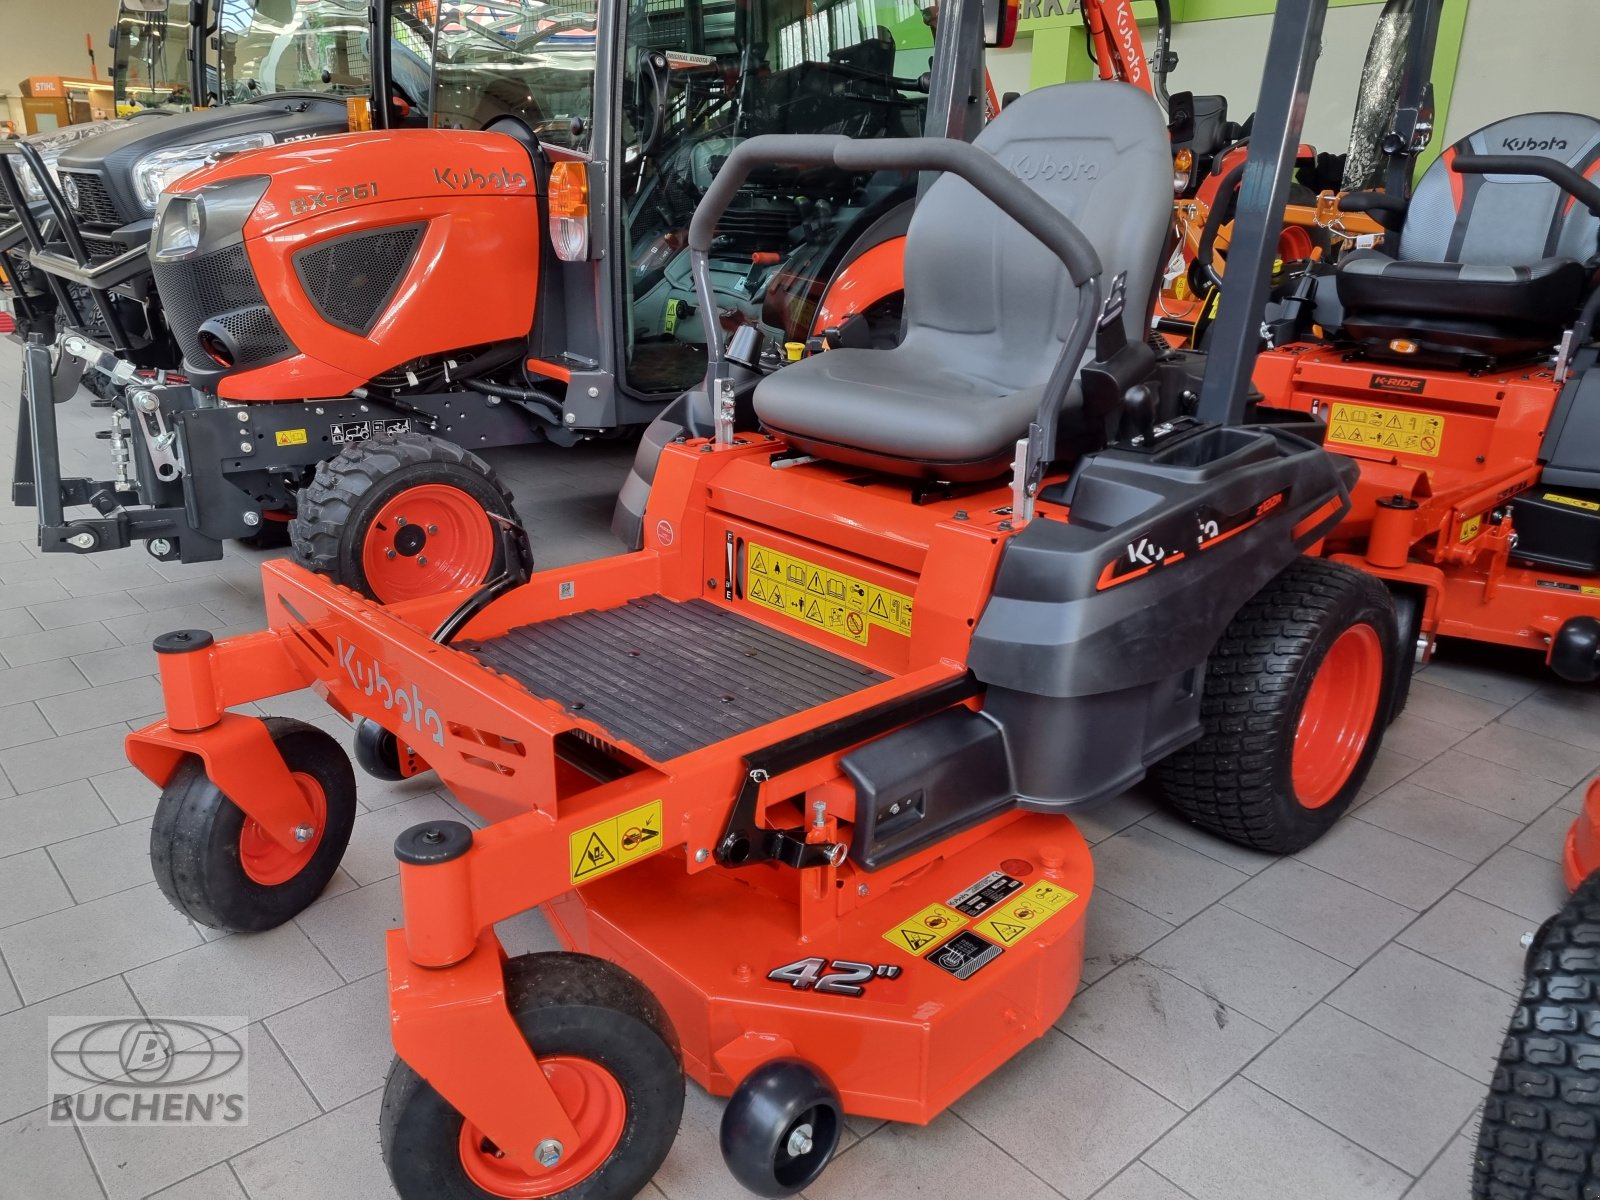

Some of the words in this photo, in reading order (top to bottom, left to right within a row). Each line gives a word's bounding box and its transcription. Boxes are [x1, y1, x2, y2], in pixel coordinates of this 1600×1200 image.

[1116, 1, 1141, 83] Kubota
[35, 82, 56, 91] STIHL
[1502, 136, 1567, 151] Kubota
[433, 166, 527, 190] Kubota
[1008, 152, 1100, 181] Kubota
[289, 182, 379, 216] BX-261
[1374, 376, 1421, 388] K-RIDE
[335, 635, 445, 747] Kubota
